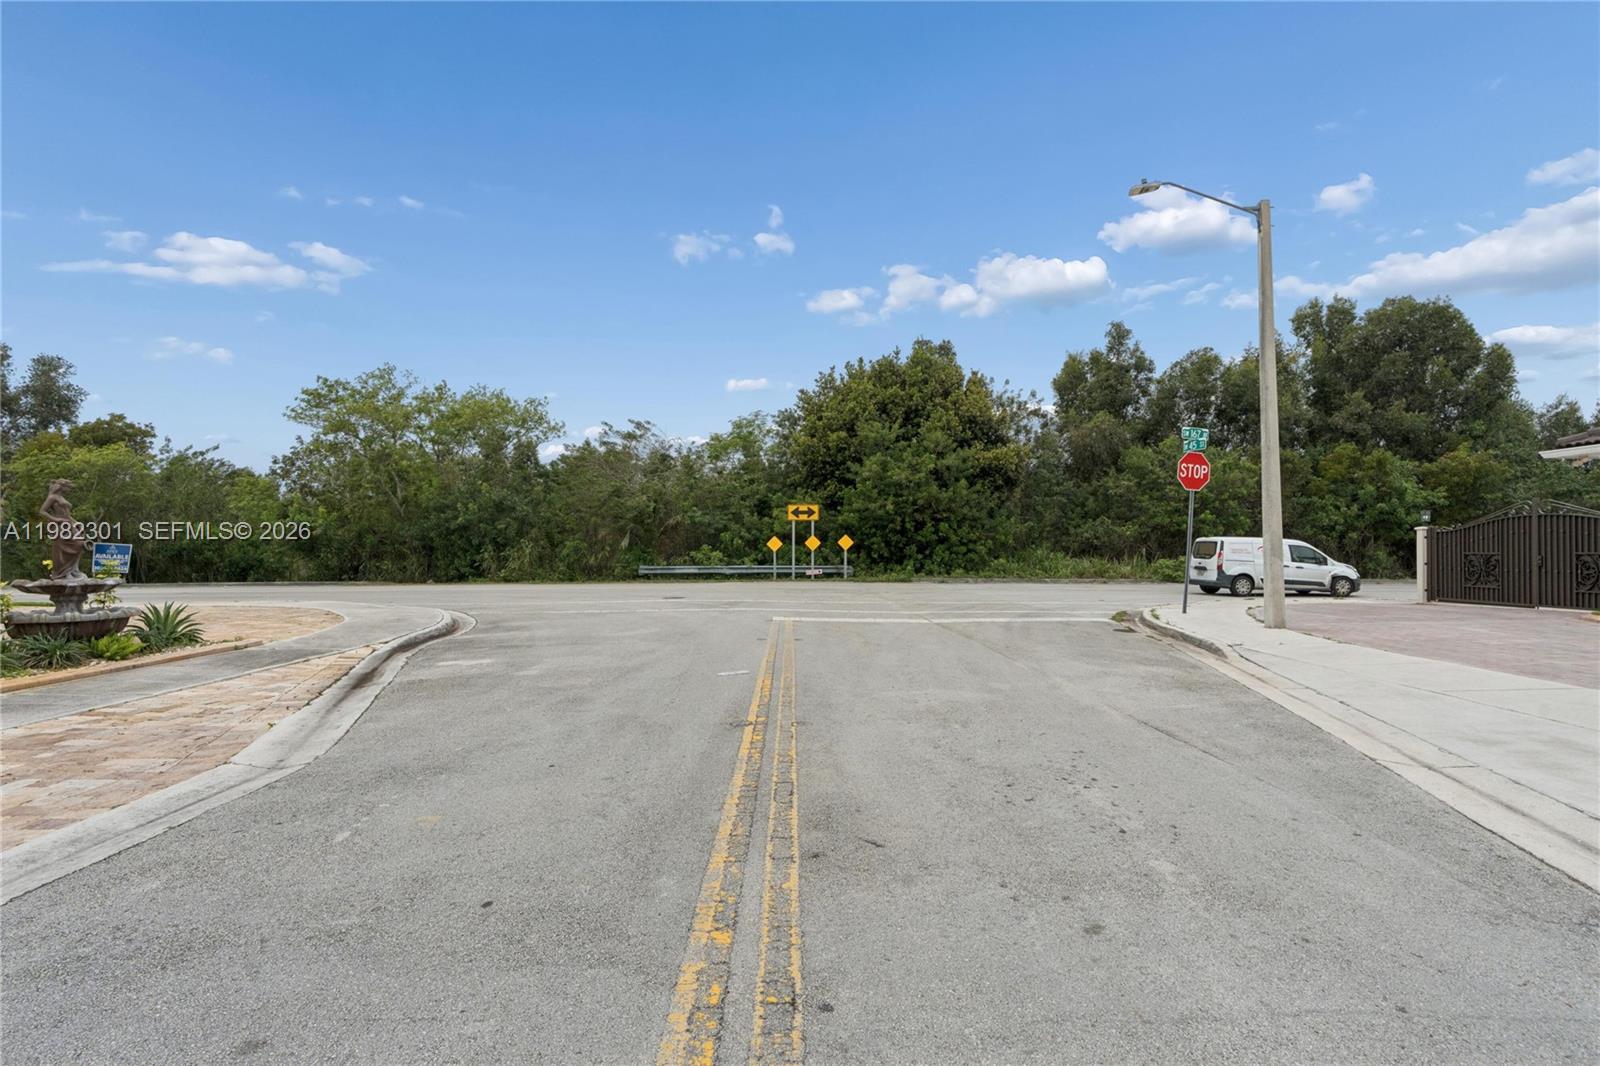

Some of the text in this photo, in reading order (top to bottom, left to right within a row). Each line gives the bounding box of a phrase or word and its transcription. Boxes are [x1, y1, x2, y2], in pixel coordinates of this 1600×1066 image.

[1190, 429, 1202, 439] 167
[1189, 441, 1197, 450] 45
[1180, 463, 1208, 480] STOP
